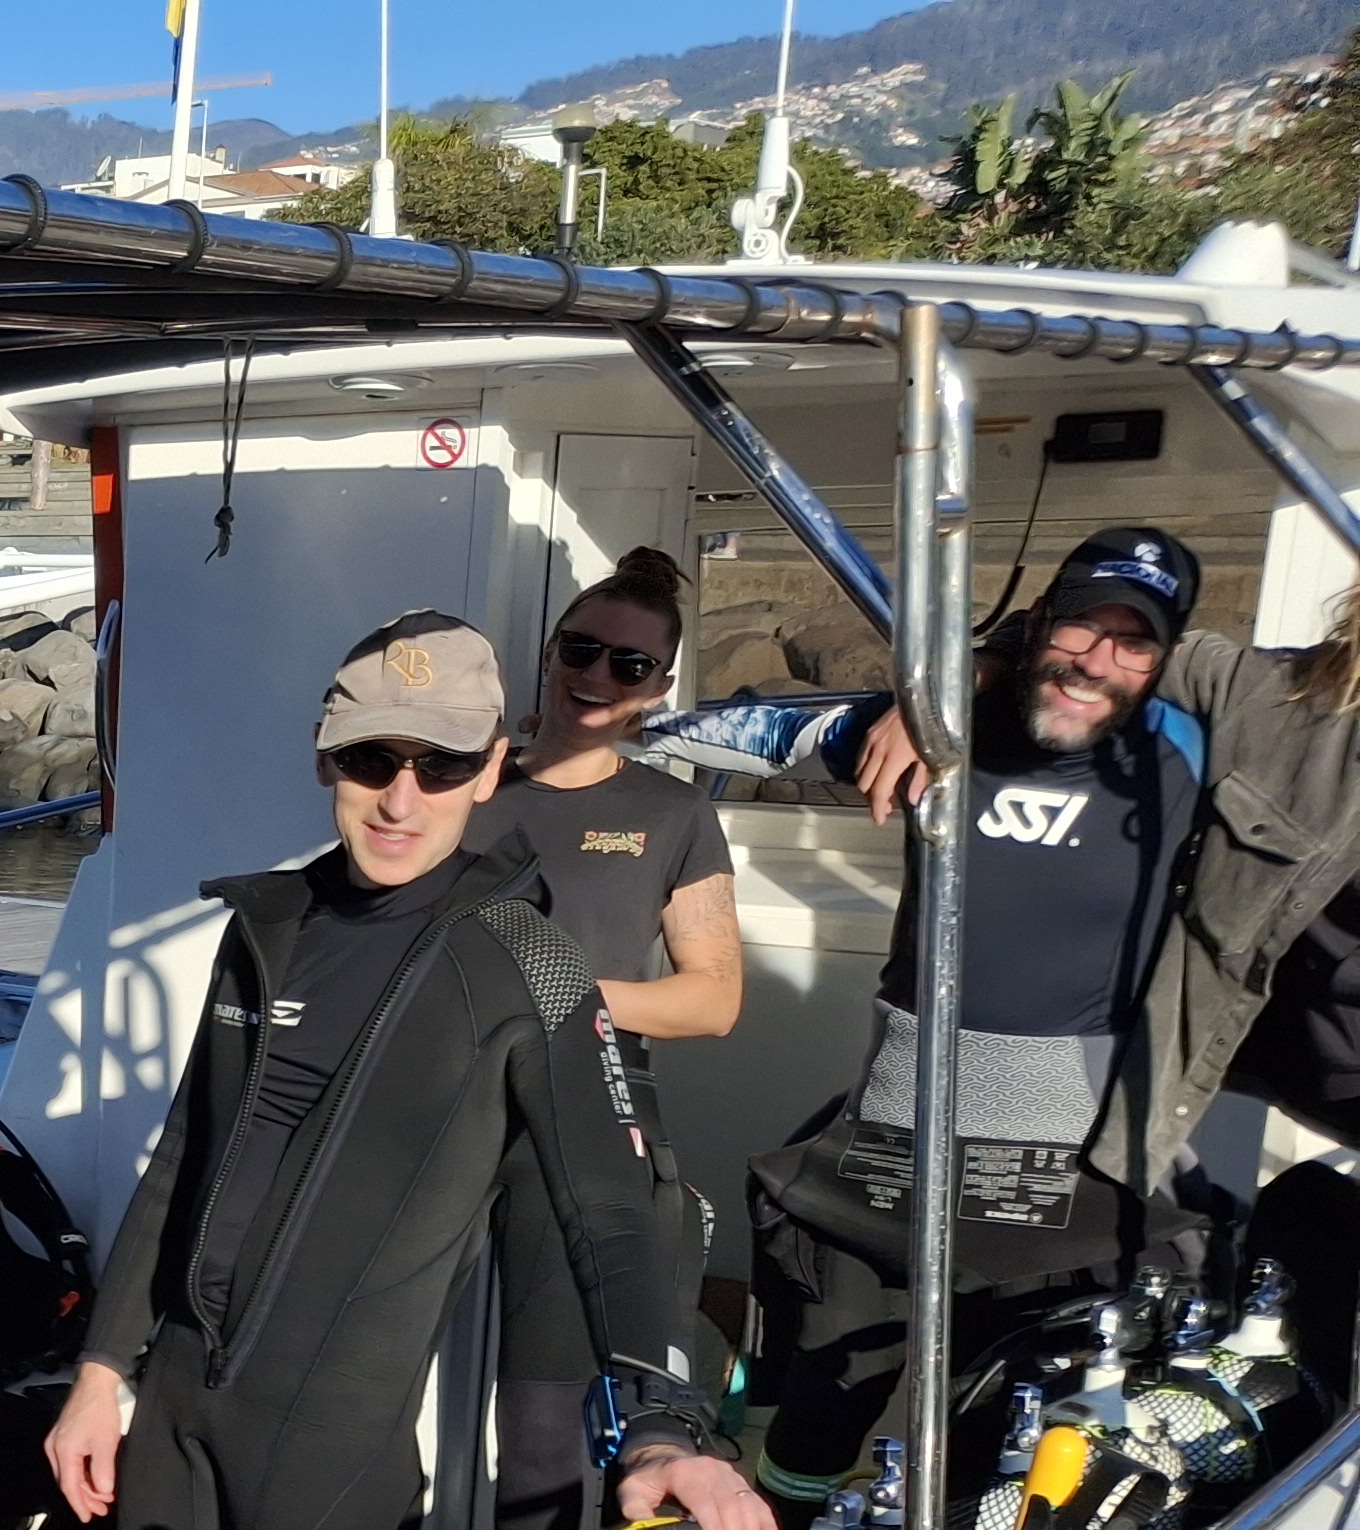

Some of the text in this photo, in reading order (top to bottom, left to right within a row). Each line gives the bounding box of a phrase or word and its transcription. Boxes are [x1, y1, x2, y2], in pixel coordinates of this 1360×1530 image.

[597, 1008, 635, 1116] mares
[599, 1052, 623, 1115] diving center
